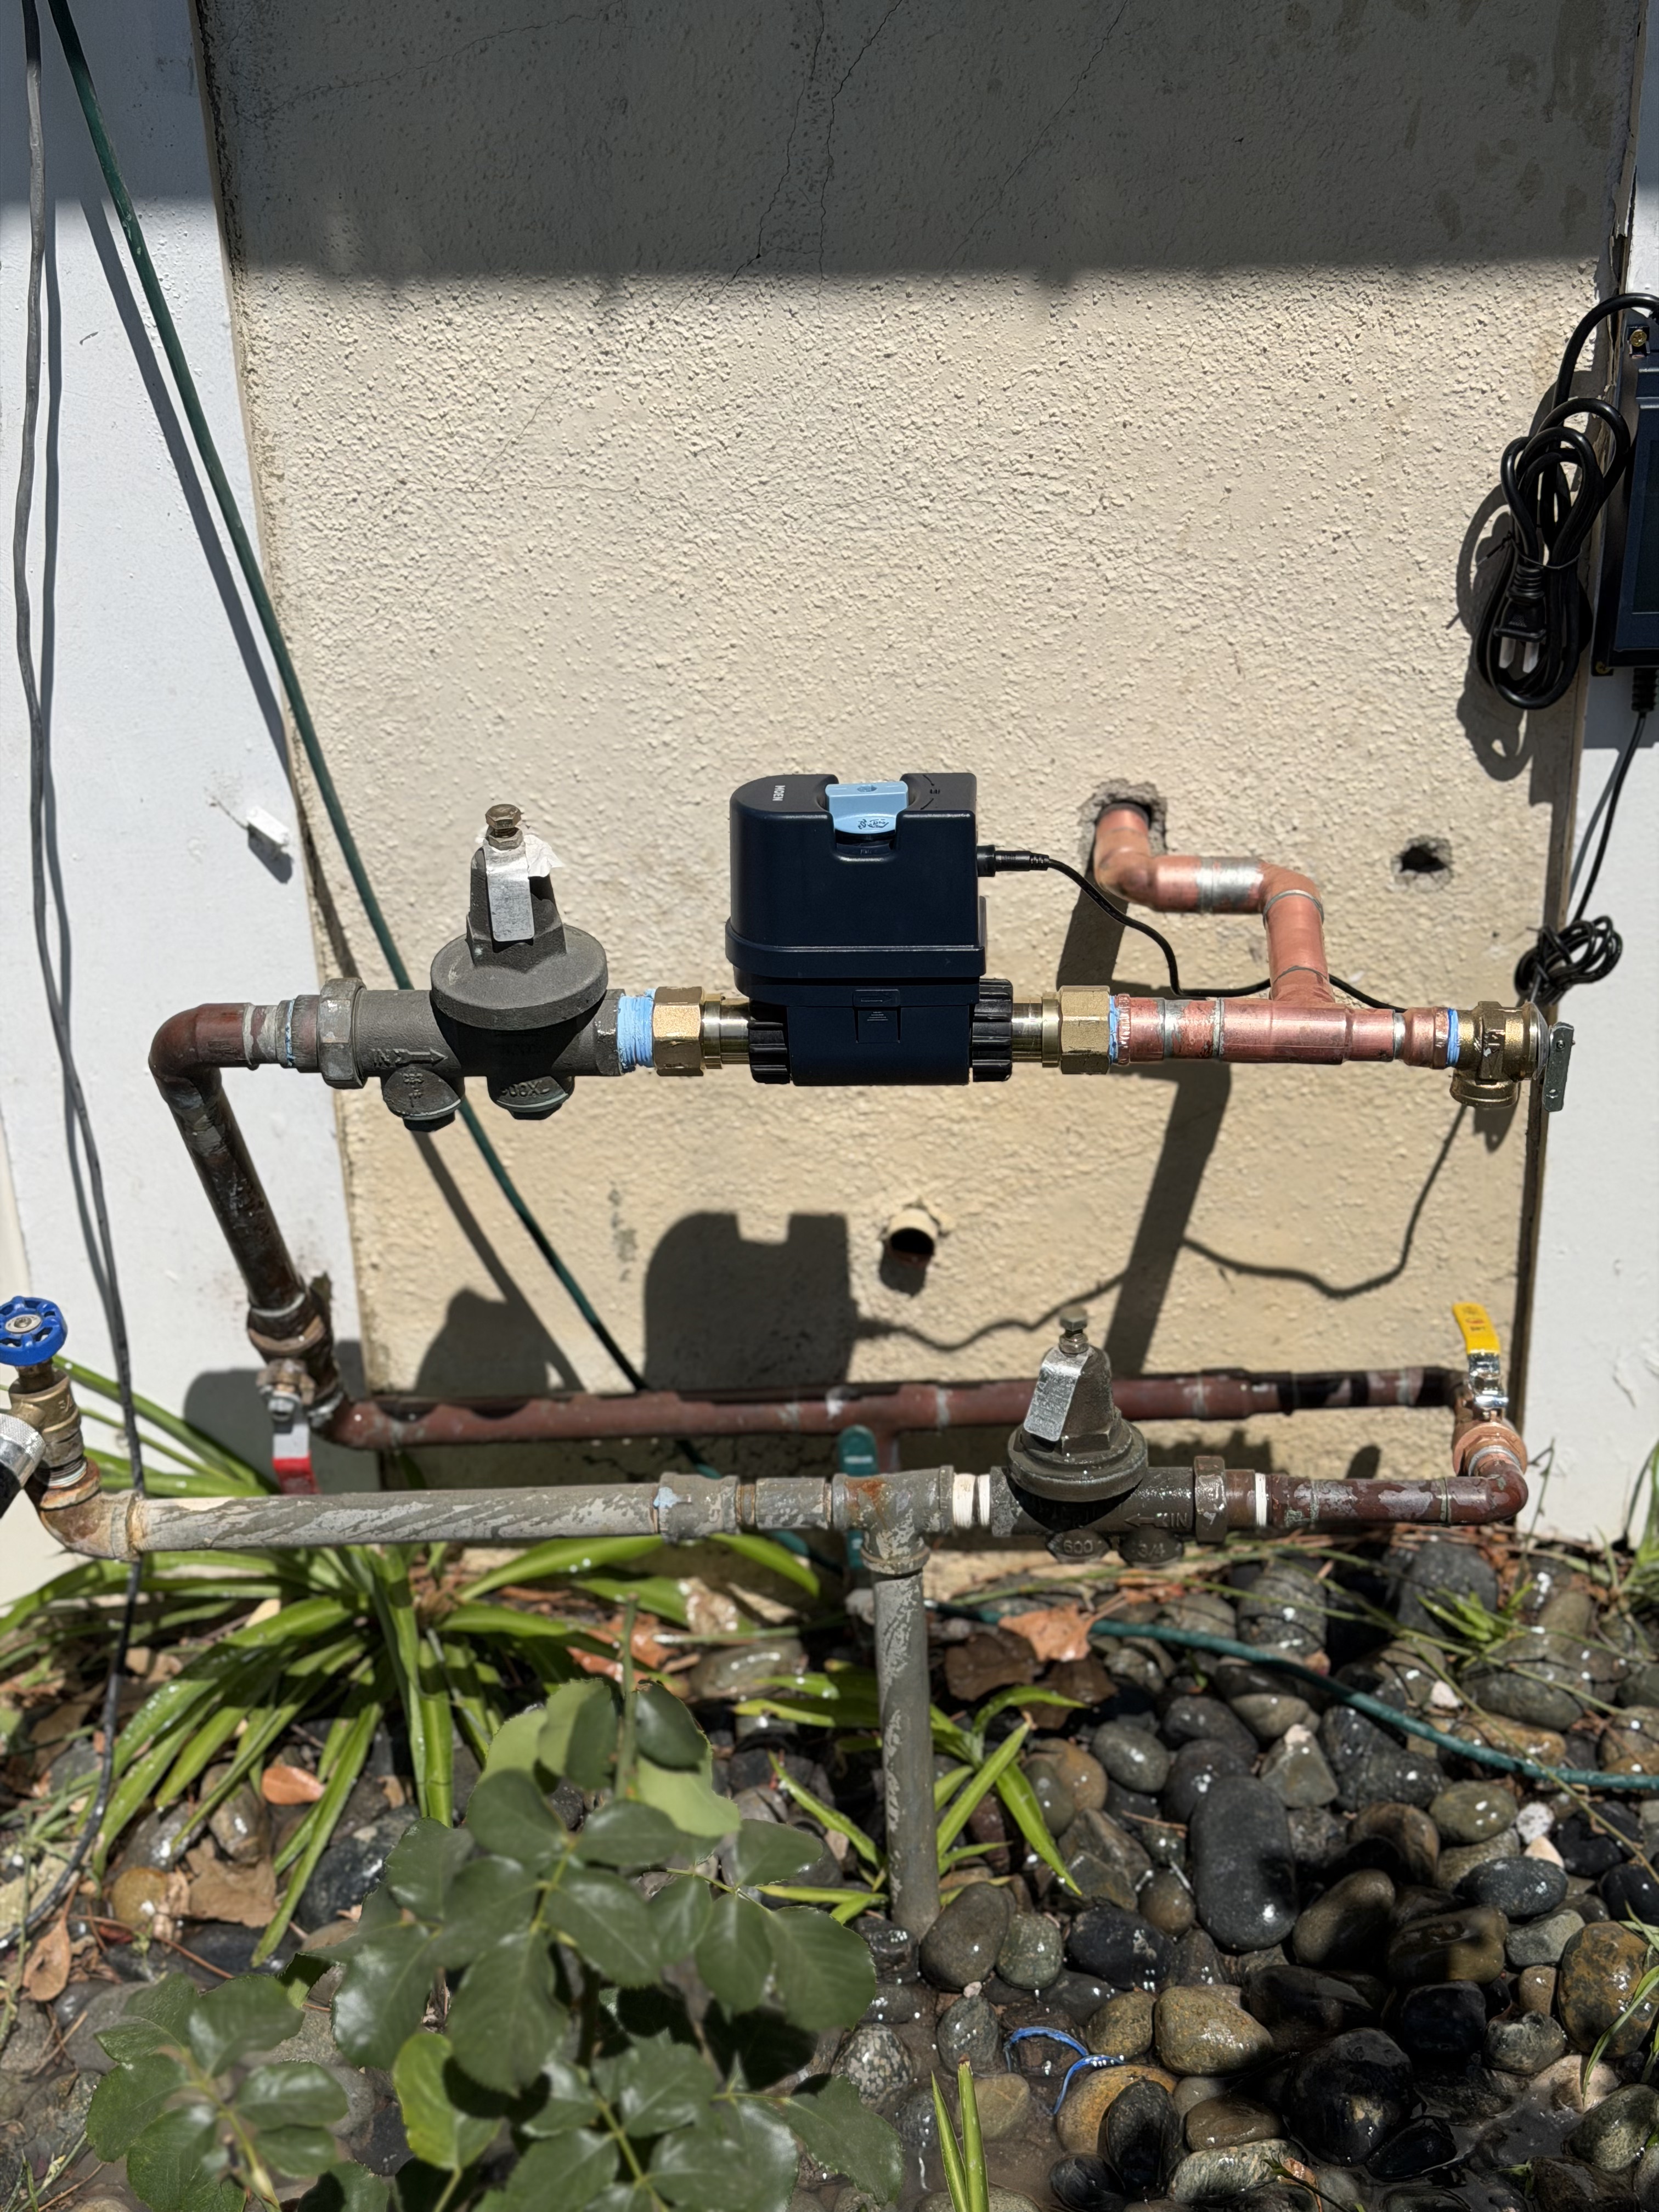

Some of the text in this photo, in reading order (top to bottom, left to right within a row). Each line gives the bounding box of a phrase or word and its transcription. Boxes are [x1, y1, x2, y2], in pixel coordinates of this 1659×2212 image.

[772, 785, 786, 801] MOEN
[1170, 1512, 1188, 1528] IN
[1063, 1538, 1094, 1555] 600
[1137, 1542, 1166, 1559] 3/4
